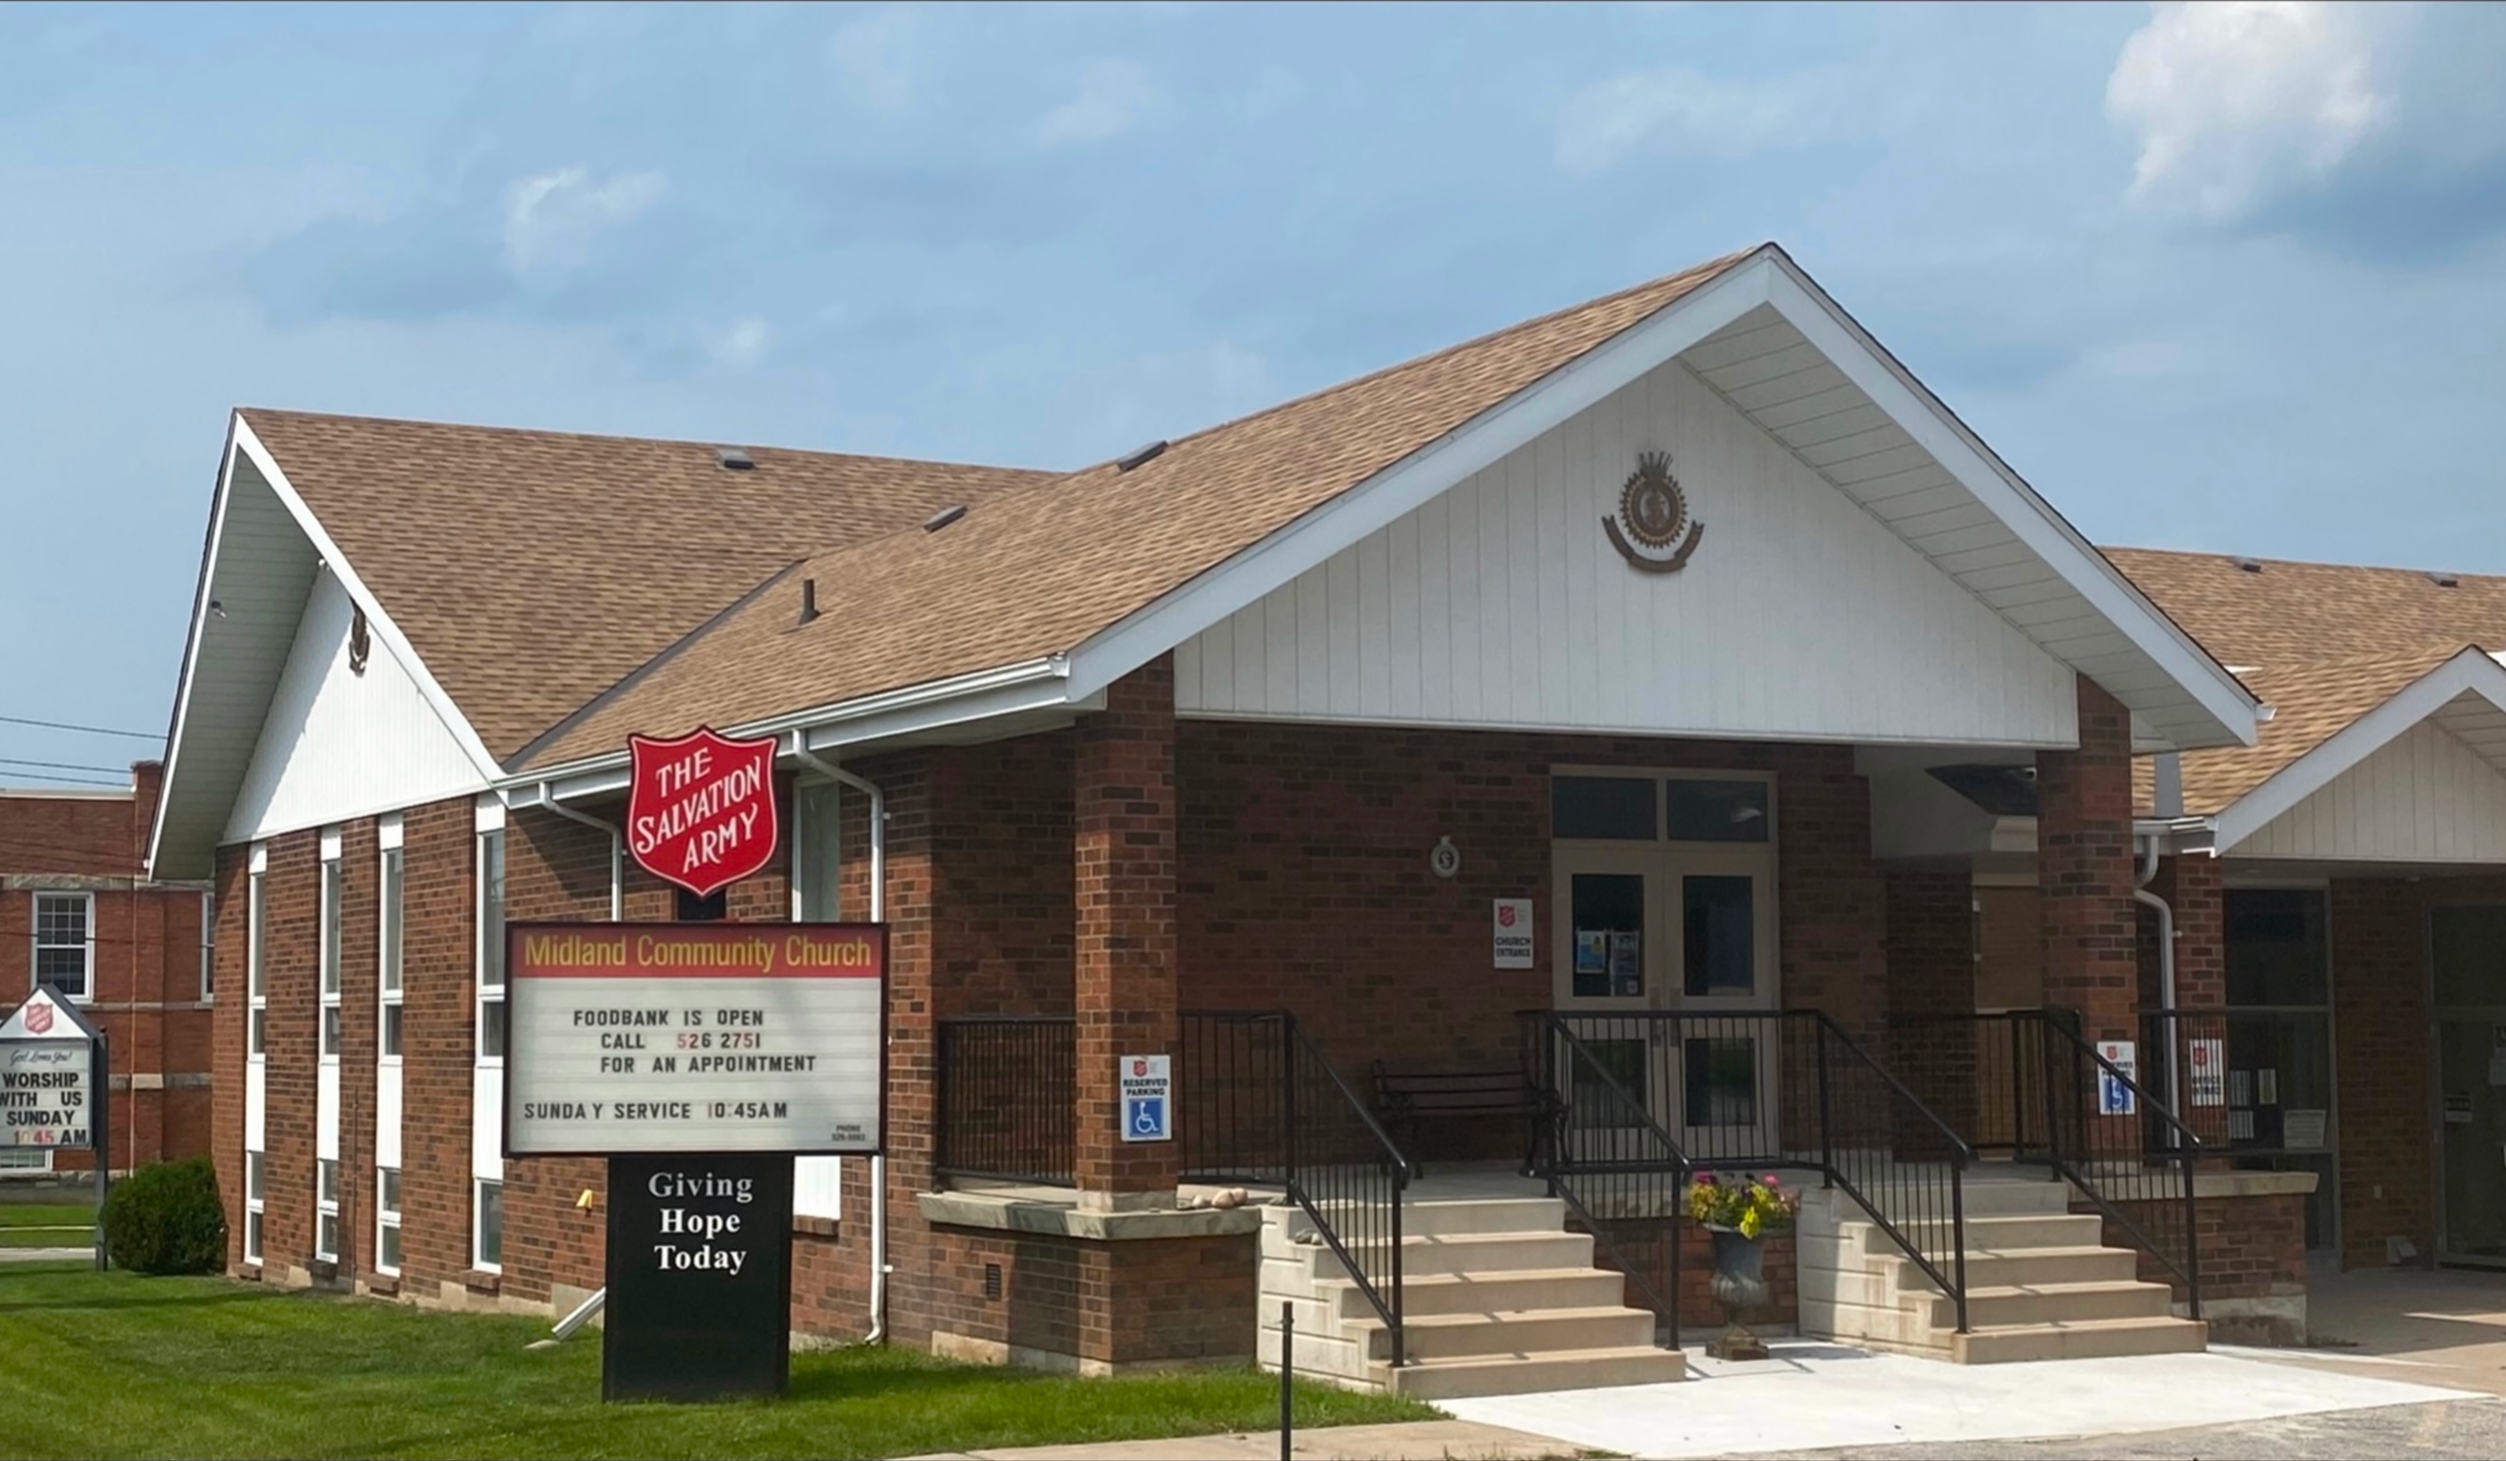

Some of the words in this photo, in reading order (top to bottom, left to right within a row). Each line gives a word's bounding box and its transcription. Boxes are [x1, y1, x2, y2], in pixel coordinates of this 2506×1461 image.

[656, 747, 712, 798] THE
[636, 755, 761, 854] SALVATION
[682, 802, 758, 874] ARMY
[525, 935, 626, 967] Midland
[637, 935, 776, 974] Community
[785, 935, 871, 967] Church
[573, 1009, 669, 1026] FOODBANK
[684, 1010, 702, 1026] IS
[717, 1009, 763, 1026] OPEN
[601, 1033, 646, 1049] CALL
[677, 1033, 711, 1049] 526
[720, 1033, 760, 1049] 2751
[601, 1057, 635, 1073] FOR
[652, 1056, 676, 1073] AN
[688, 1055, 816, 1073] APPOINTMENT
[2, 1072, 79, 1088] WORSHIP
[1123, 1079, 1168, 1088] RESERVED
[0, 1091, 38, 1107] WITH
[61, 1091, 82, 1106] US
[1126, 1088, 1165, 1097] PARKING
[6, 1110, 75, 1126] SUNDAY
[524, 1103, 604, 1119] SUNDAY
[614, 1103, 691, 1119] SERVICE
[61, 1129, 87, 1144] AM
[648, 1172, 753, 1203] Giving
[659, 1208, 741, 1240] Hope
[654, 1245, 747, 1275] Today
